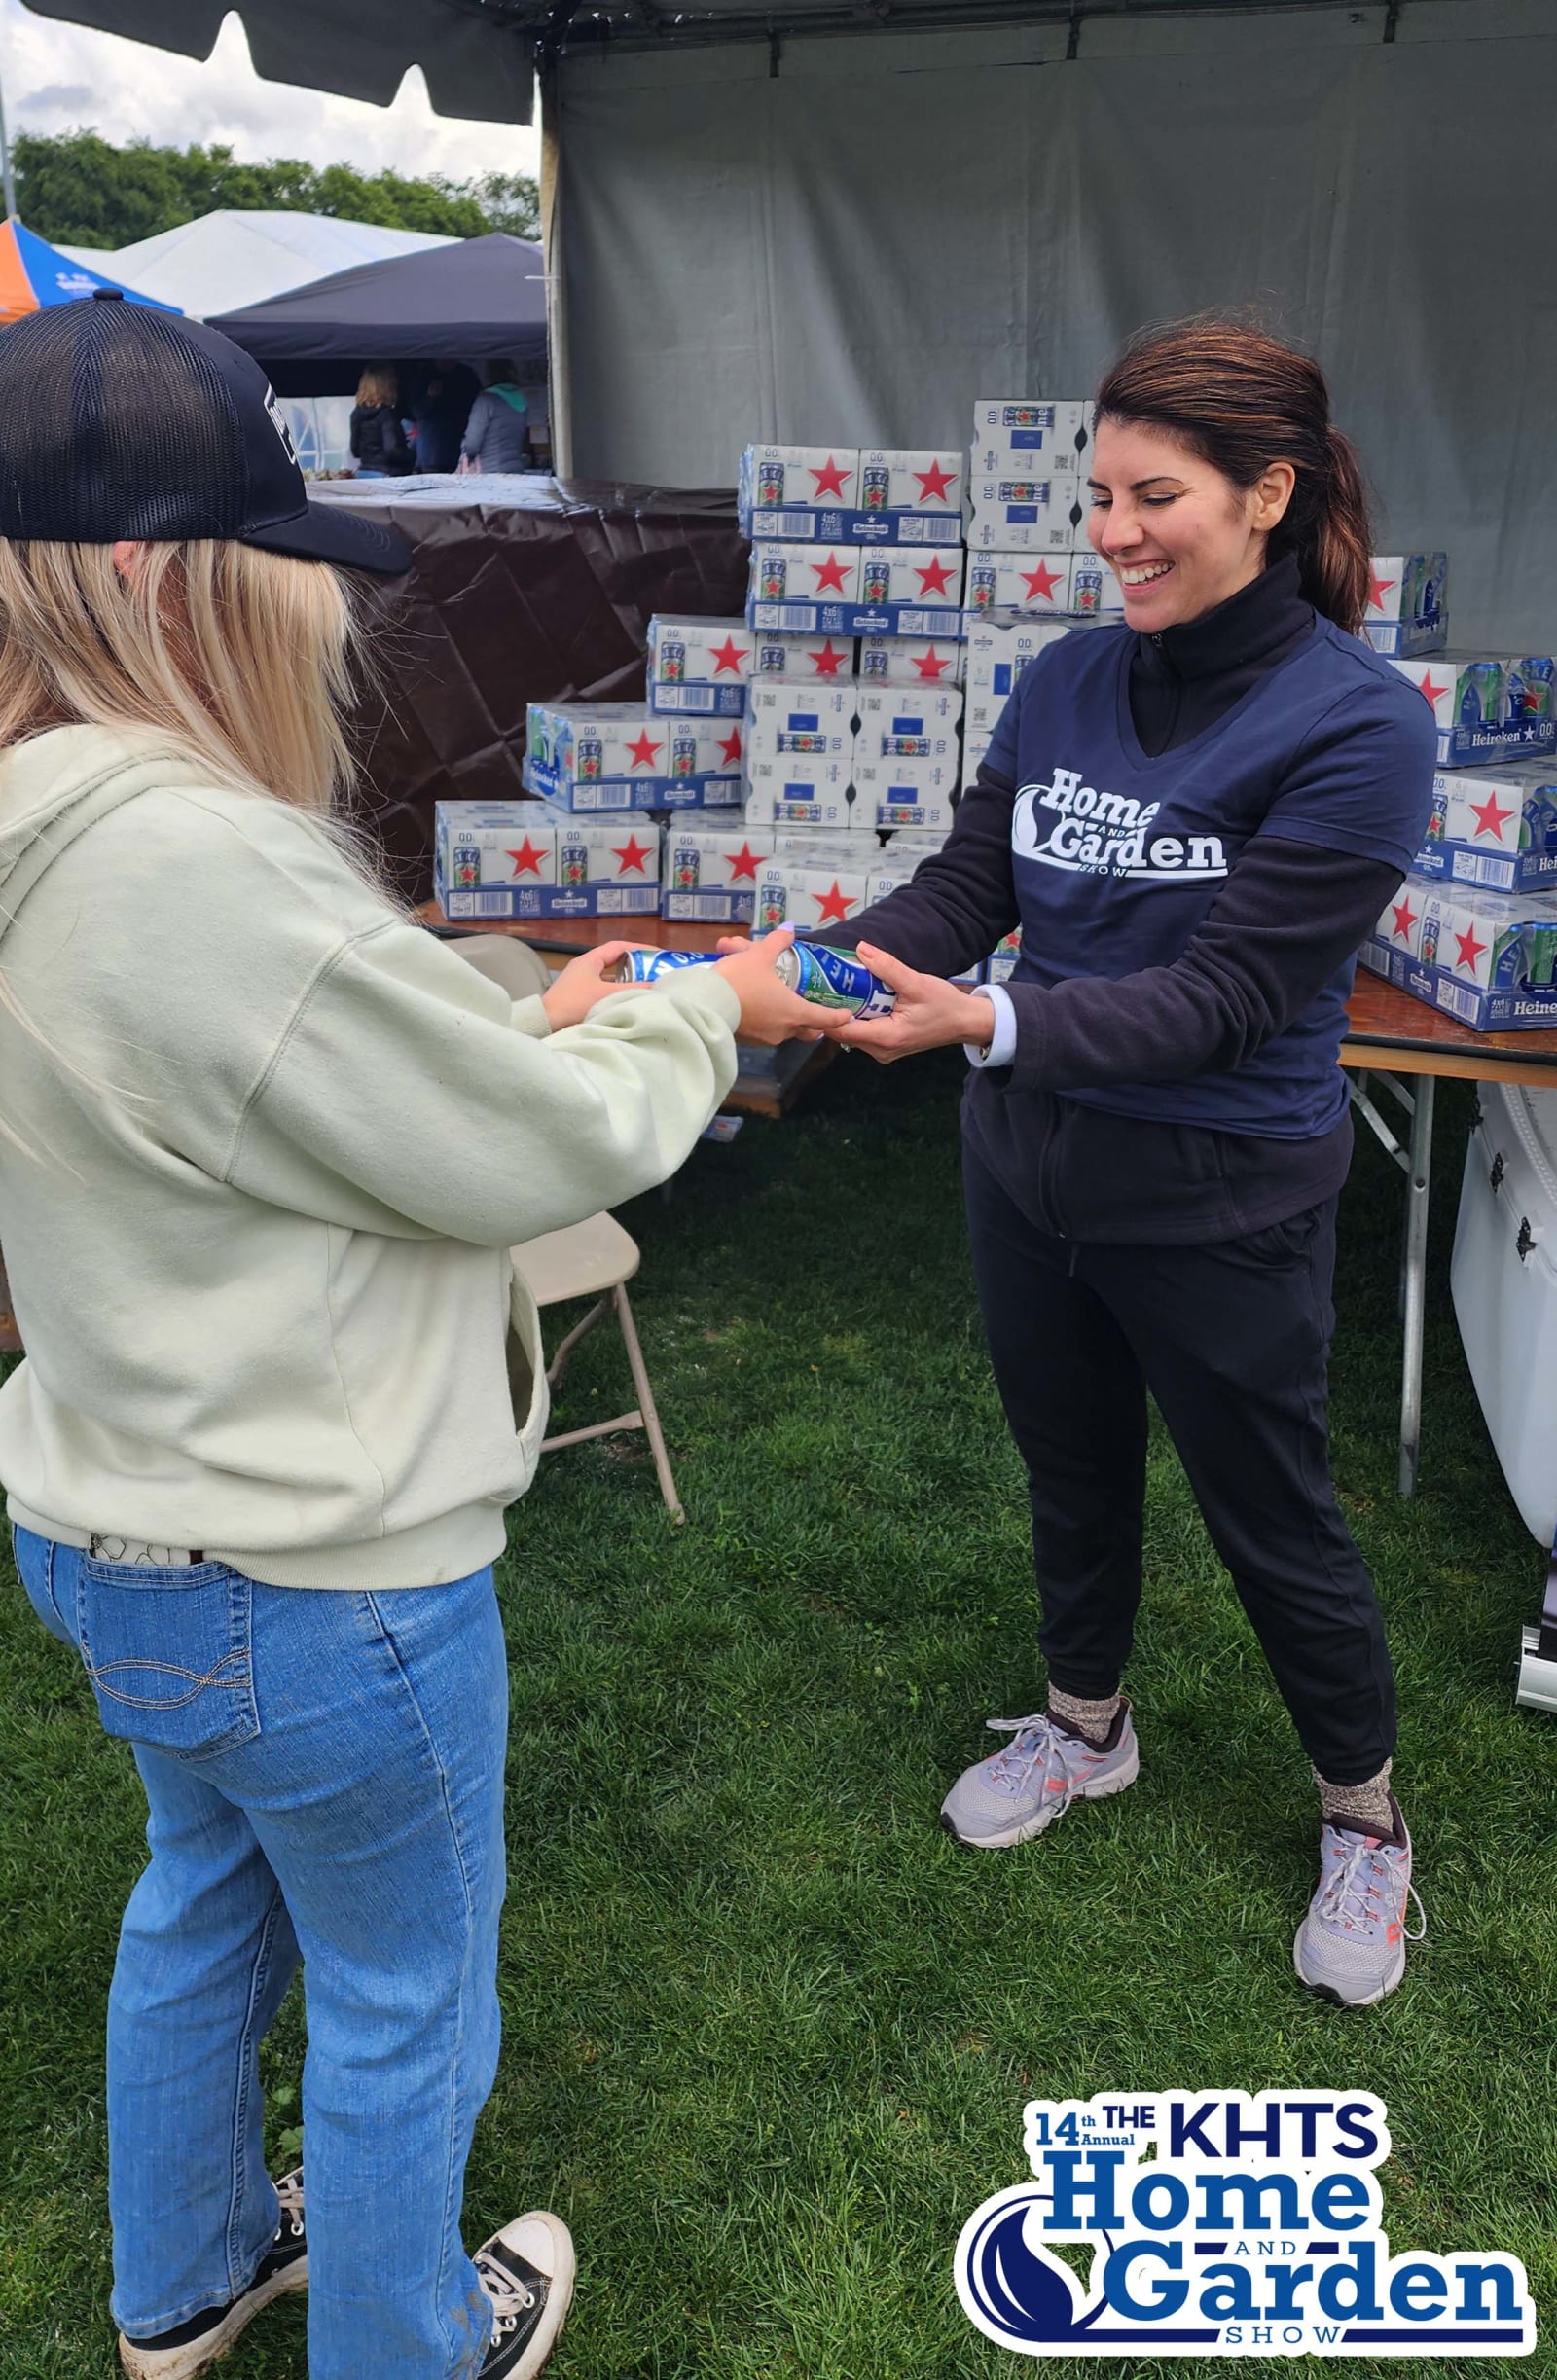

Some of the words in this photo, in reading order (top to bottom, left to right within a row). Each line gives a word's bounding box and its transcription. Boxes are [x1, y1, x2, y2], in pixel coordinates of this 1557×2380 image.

[1039, 767, 1160, 827] Home
[1050, 818, 1227, 868] Garden
[1098, 825, 1125, 838] AND
[1079, 863, 1127, 878] SHOW
